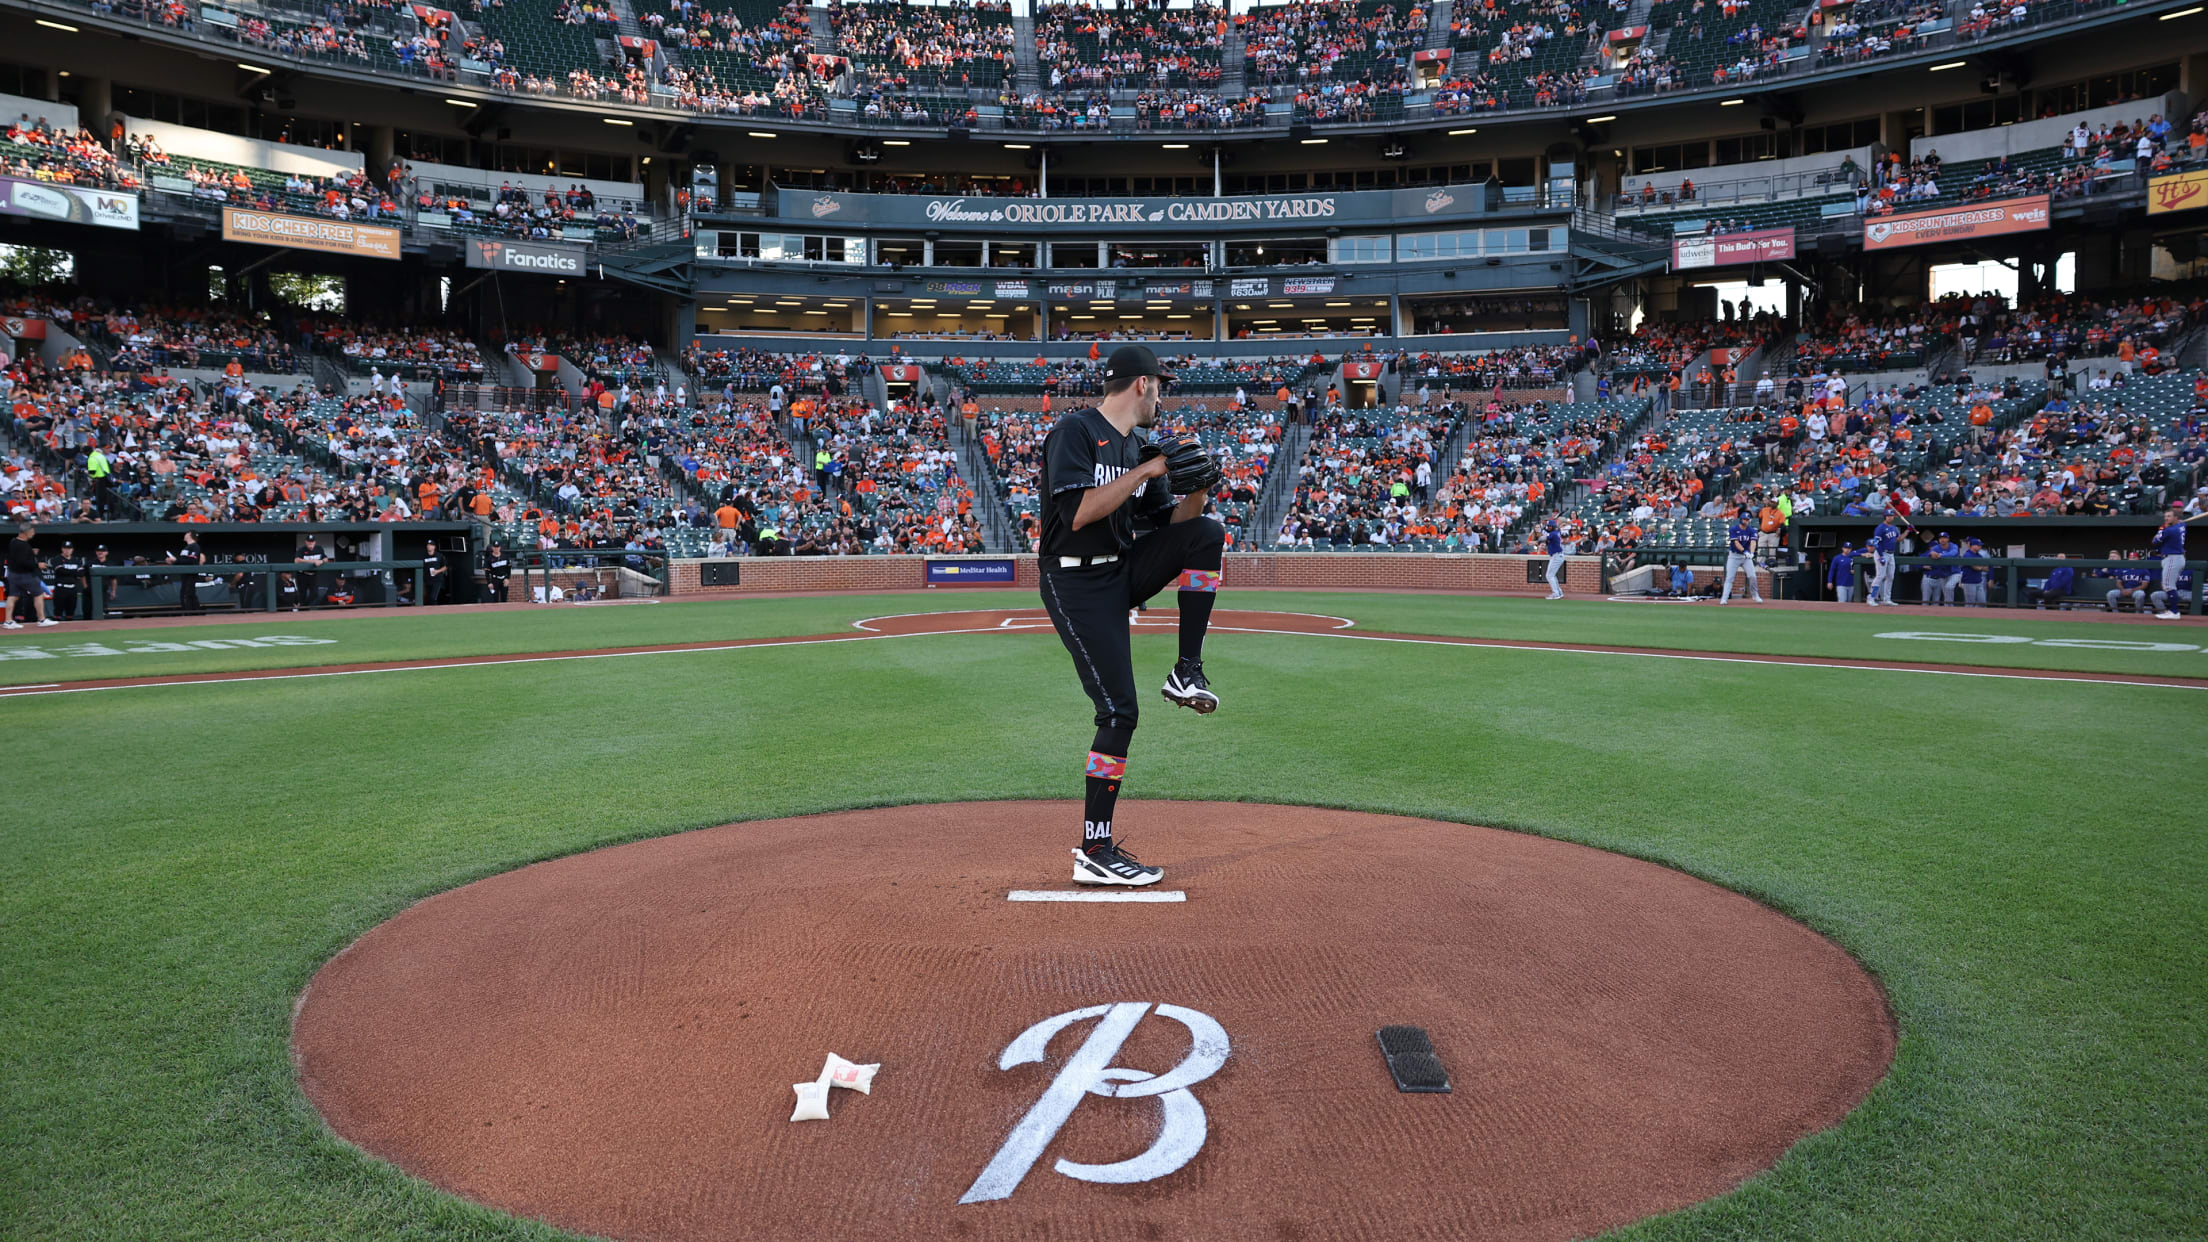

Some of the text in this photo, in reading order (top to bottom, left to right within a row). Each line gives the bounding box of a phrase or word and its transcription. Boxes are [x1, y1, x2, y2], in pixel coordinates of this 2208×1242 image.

[926, 199, 989, 222] Welcome
[989, 209, 1004, 222] to
[1005, 204, 1086, 223] ORIOLE
[1088, 204, 1145, 223] PARK
[1168, 201, 1261, 220] CAMDEN
[1264, 198, 1335, 219] YARDS
[2012, 208, 2046, 221] weis
[231, 212, 354, 243] KIDS CHEER FREE
[1891, 208, 2006, 234] KIDS RUN THE BASES
[1915, 225, 1976, 239] EVERY SUNDAY
[1718, 243, 1735, 253] This
[1735, 241, 1757, 251] Bud's
[1771, 239, 1789, 248] You.
[505, 248, 577, 270] Fanatics
[996, 281, 1028, 289] WBAL
[1048, 282, 1093, 297] masn
[1097, 280, 1116, 289] EVERY
[1194, 280, 1214, 289] EVERY
[1231, 278, 1269, 289] ESPN
[213, 554, 268, 564] LEOM
[384, 571, 391, 580] 4
[960, 566, 985, 574] MedStar
[1085, 820, 1112, 840] BAL
[959, 1001, 1231, 1205] B
